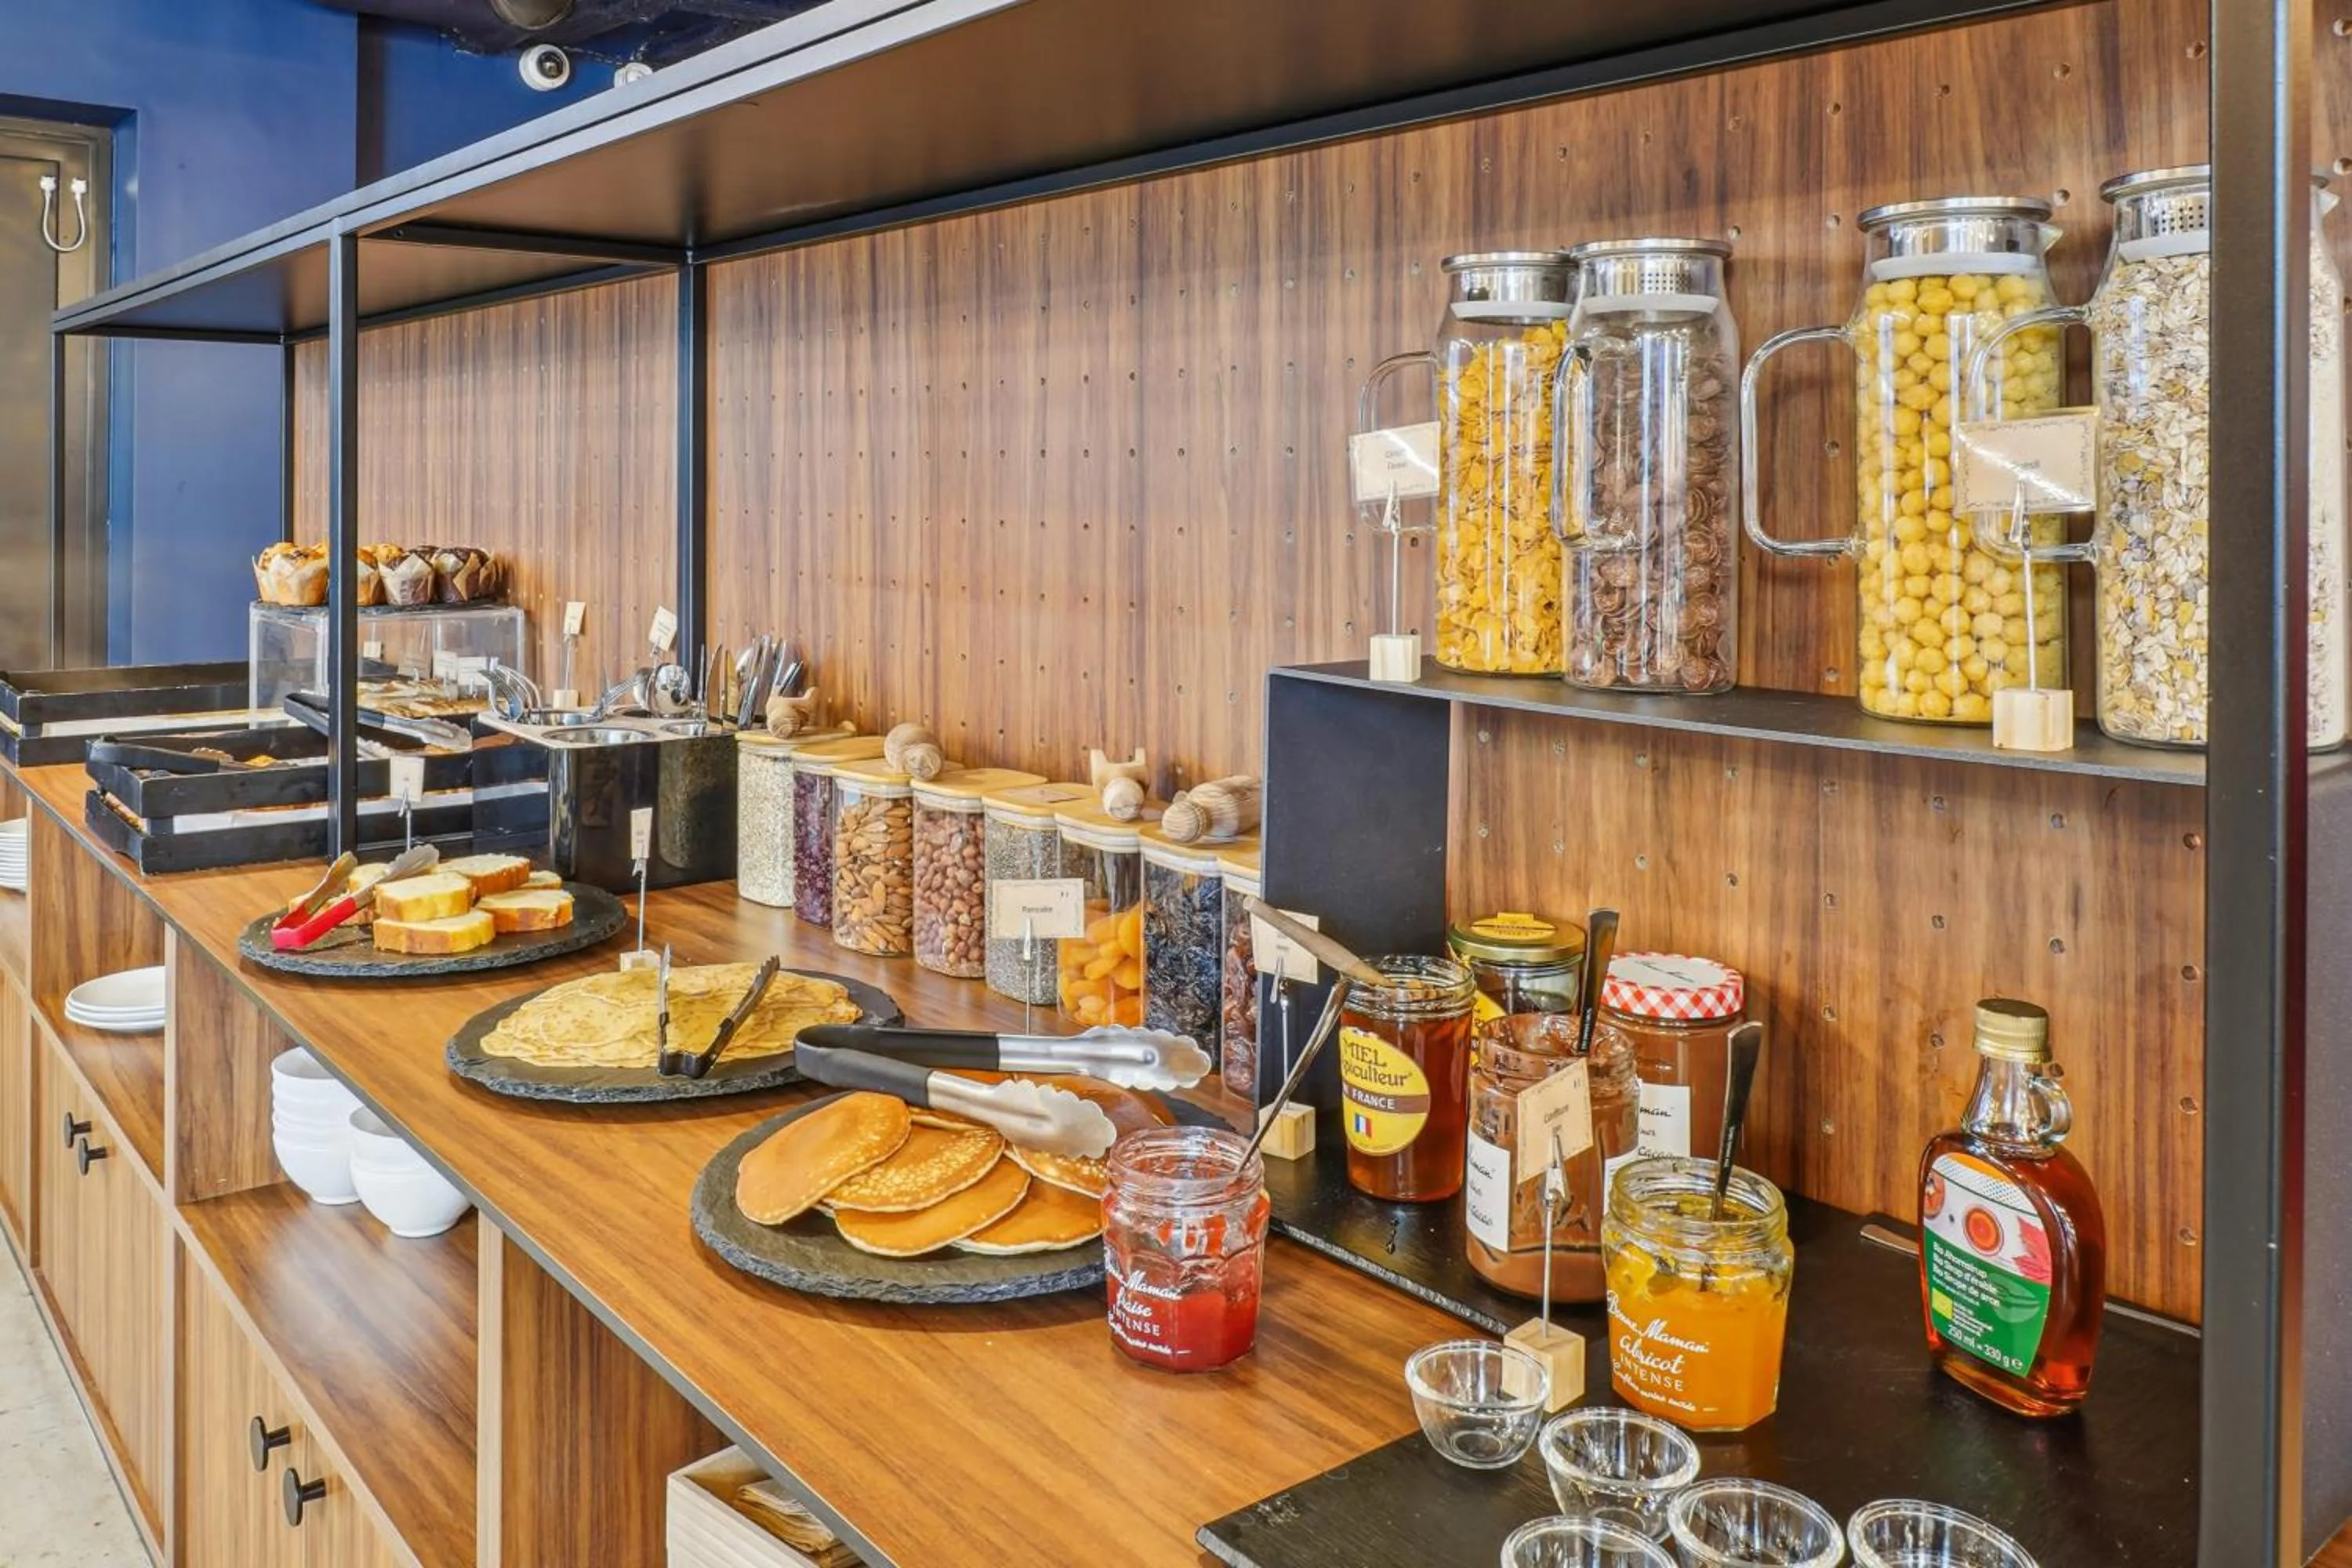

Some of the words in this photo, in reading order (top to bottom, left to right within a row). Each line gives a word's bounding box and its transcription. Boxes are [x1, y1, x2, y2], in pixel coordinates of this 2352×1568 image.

[1352, 1088, 1396, 1109] FRANCE
[1112, 1305, 1160, 1337] INTENSE
[1642, 1318, 1709, 1353] Maman
[1620, 1353, 1684, 1392] INTENSE
